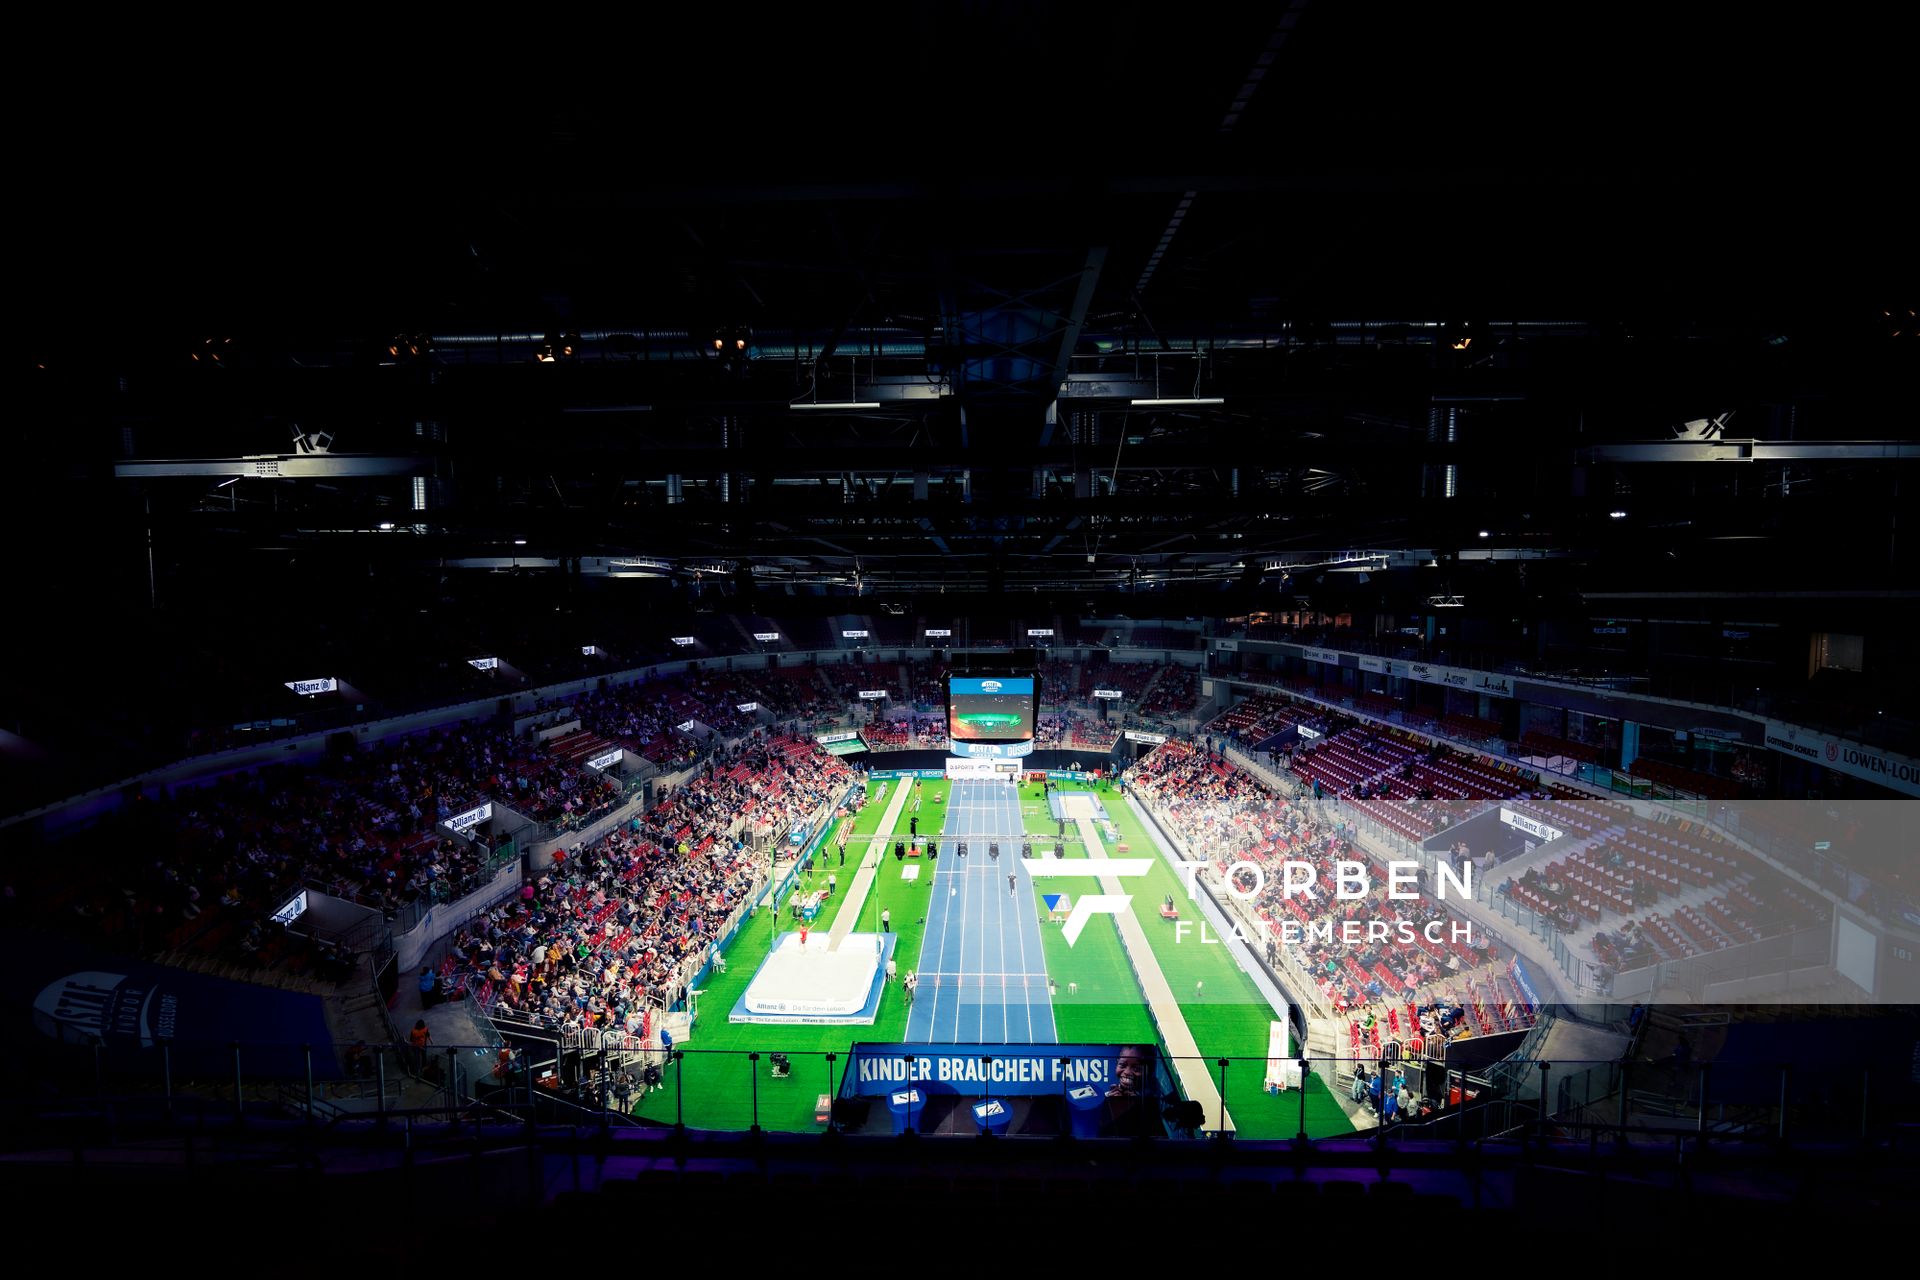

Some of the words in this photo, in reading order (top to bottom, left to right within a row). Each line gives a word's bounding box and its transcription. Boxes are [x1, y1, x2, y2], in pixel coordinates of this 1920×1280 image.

[451, 812, 476, 830] Allianz
[1512, 814, 1538, 833] Allianz
[115, 988, 144, 1035] INDOOR
[859, 1058, 931, 1082] KINDER
[938, 1058, 1044, 1083] BRAUCHEN
[1051, 1059, 1109, 1083] FANS!
